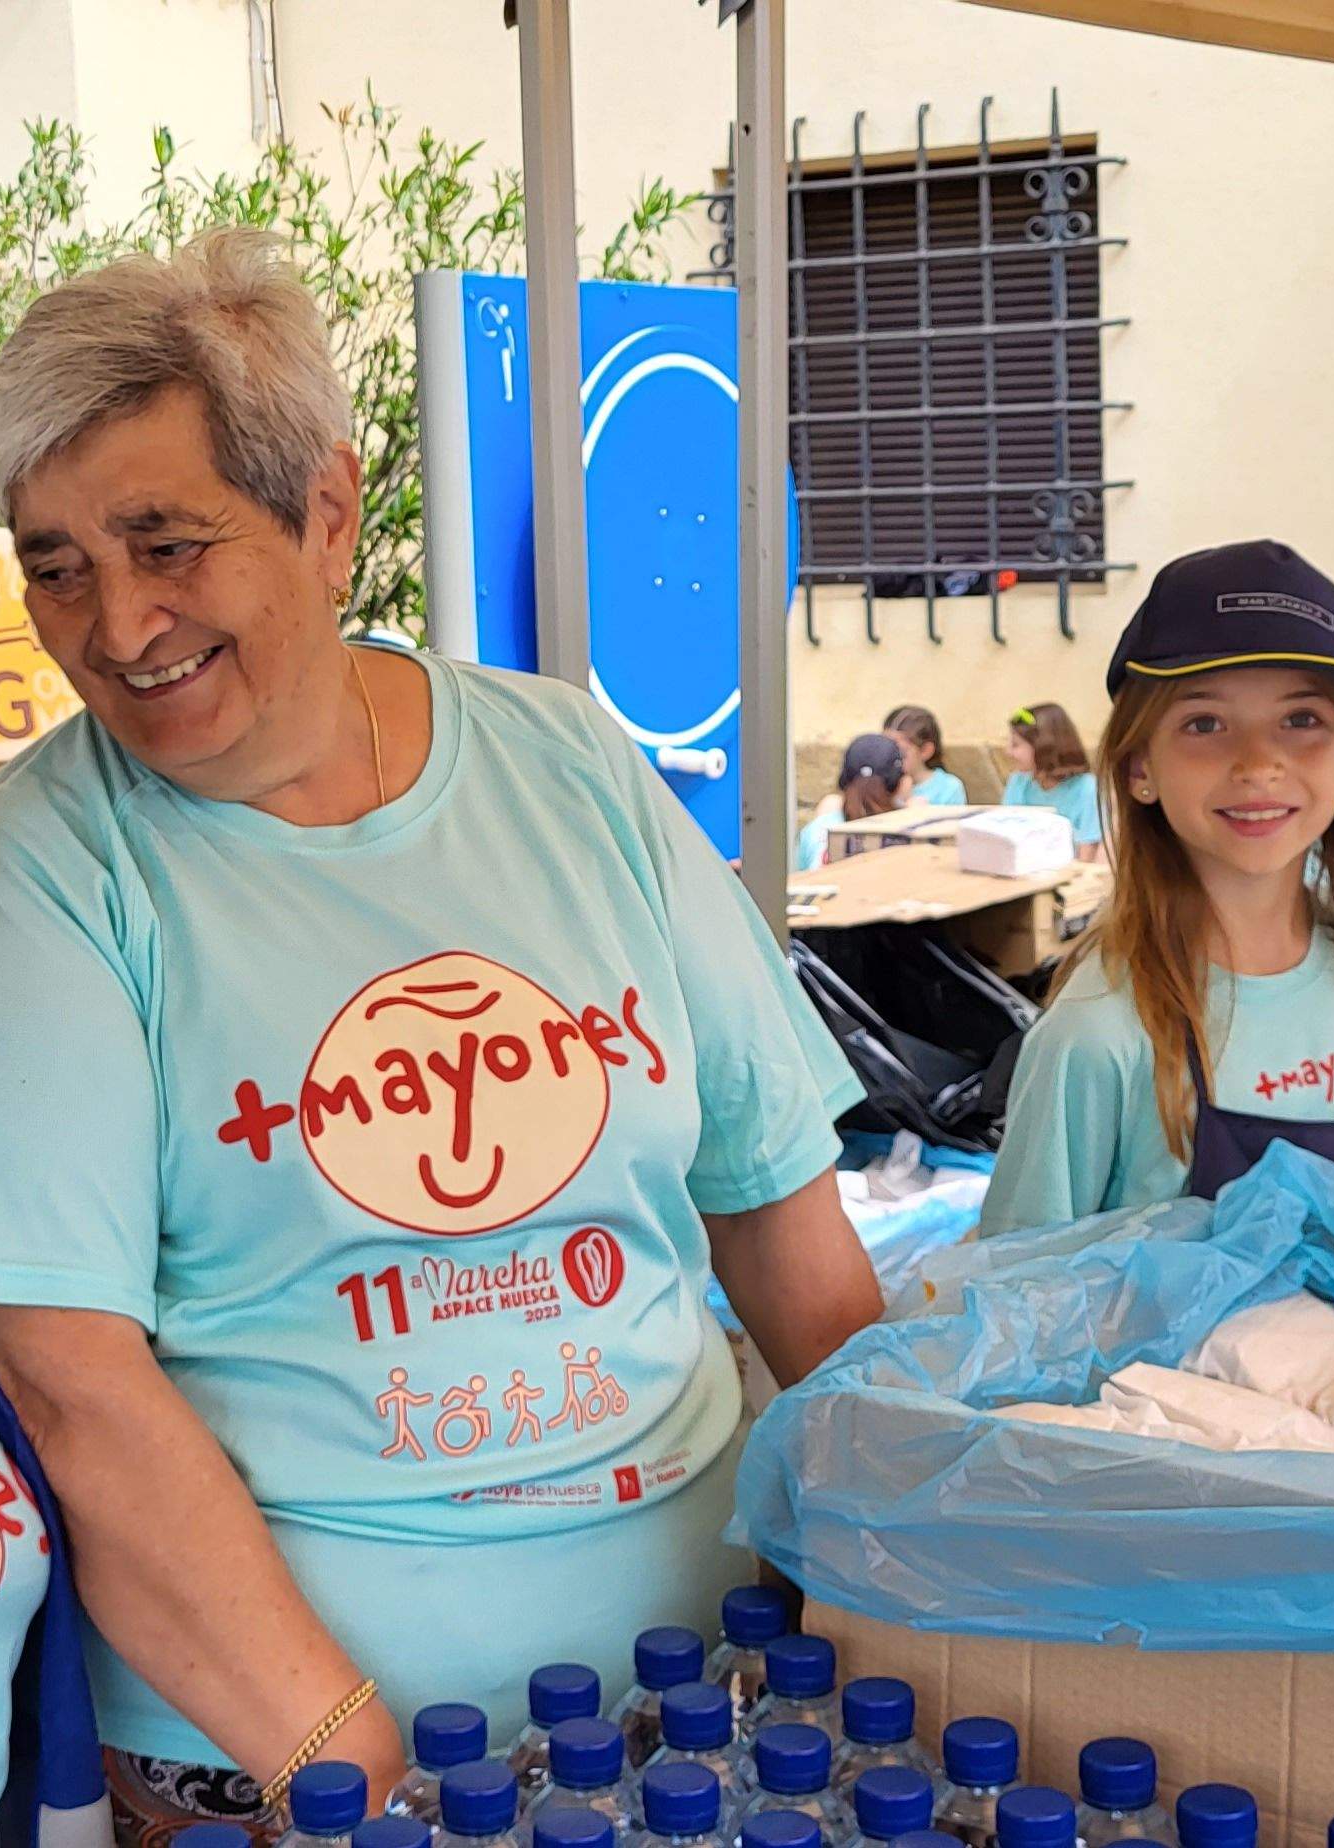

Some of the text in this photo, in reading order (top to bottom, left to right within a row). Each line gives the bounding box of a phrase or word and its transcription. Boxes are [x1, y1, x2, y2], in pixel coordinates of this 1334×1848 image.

[420, 1250, 555, 1300] Marcha
[432, 1285, 561, 1323] ASPACE HUESCA
